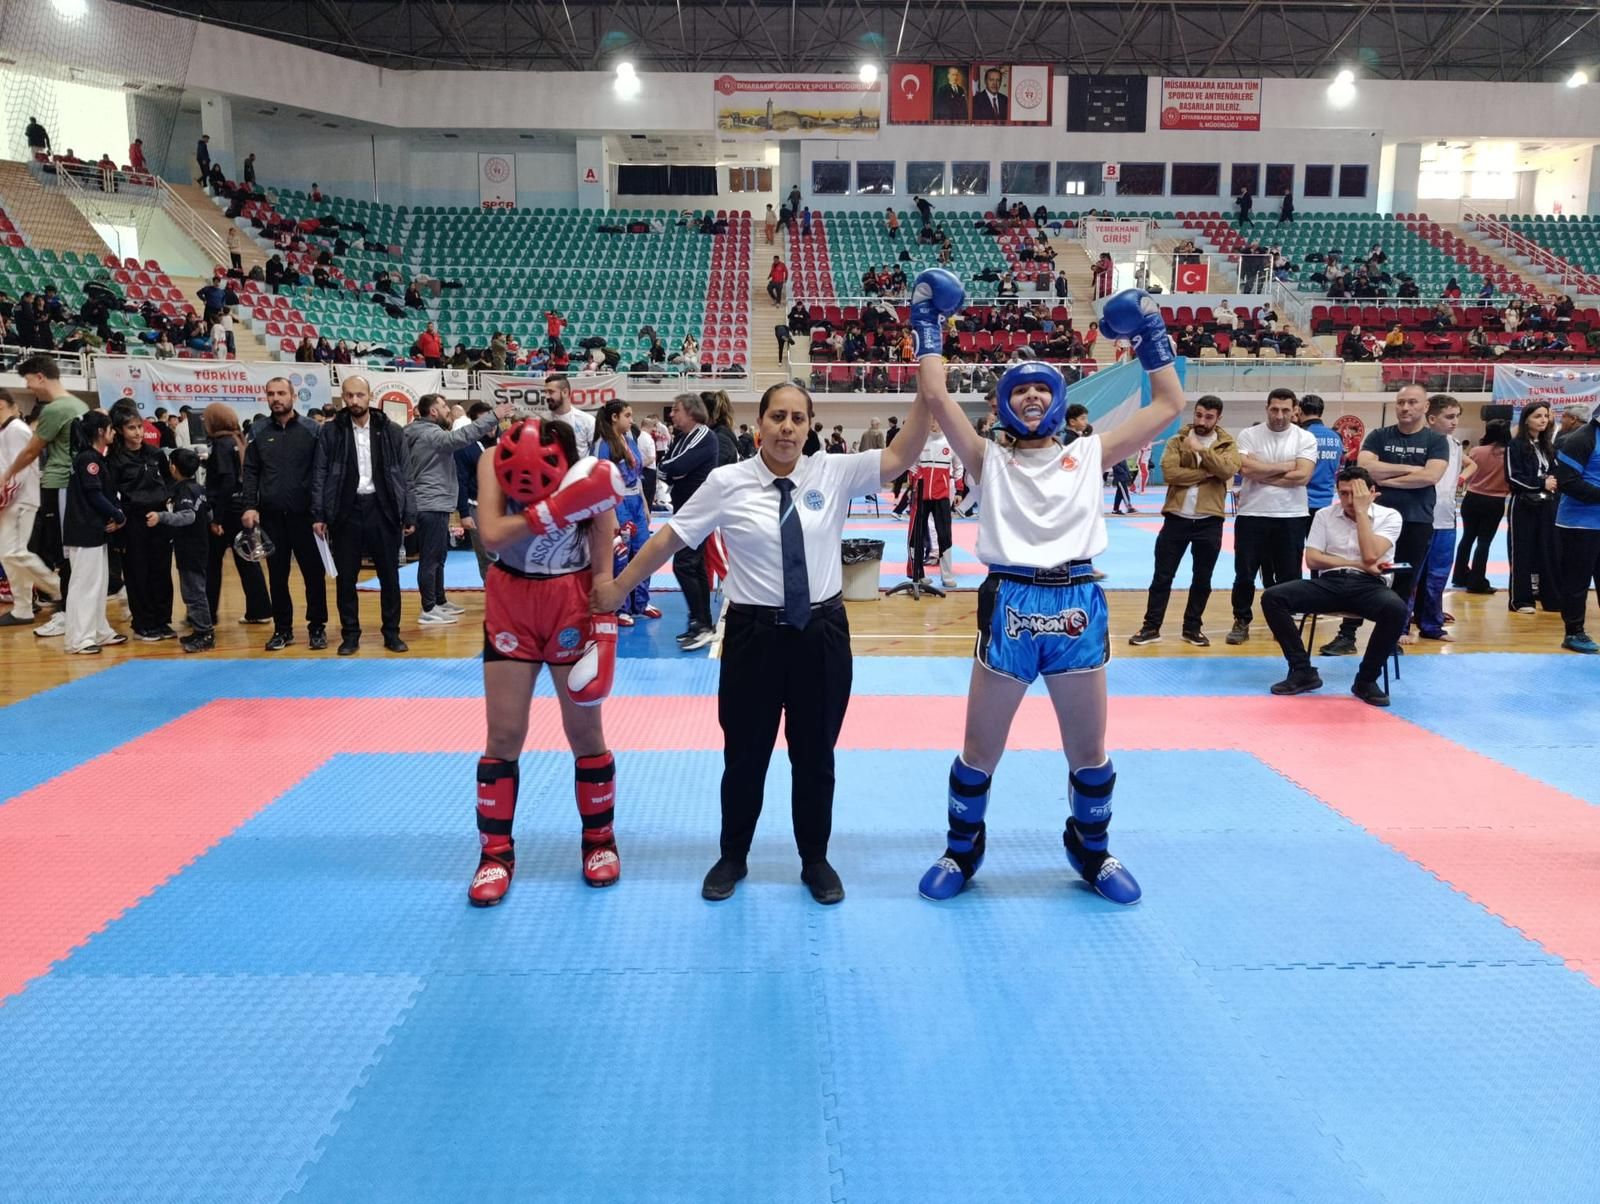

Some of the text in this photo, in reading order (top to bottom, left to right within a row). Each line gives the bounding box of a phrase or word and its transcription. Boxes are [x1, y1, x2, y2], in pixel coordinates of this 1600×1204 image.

[1217, 81, 1243, 90] KATILAN
[1245, 80, 1259, 90] TÜM
[1168, 91, 1193, 100] SPORCU
[1195, 92, 1202, 100] VE
[586, 168, 596, 179] A
[1107, 166, 1116, 176] B
[1096, 225, 1140, 233] YEMEKHANE
[1103, 234, 1132, 245] GİRİŞİ
[194, 369, 248, 381] TÜRKİYE
[185, 384, 218, 394] BOKS
[222, 384, 268, 394] TURNUV
